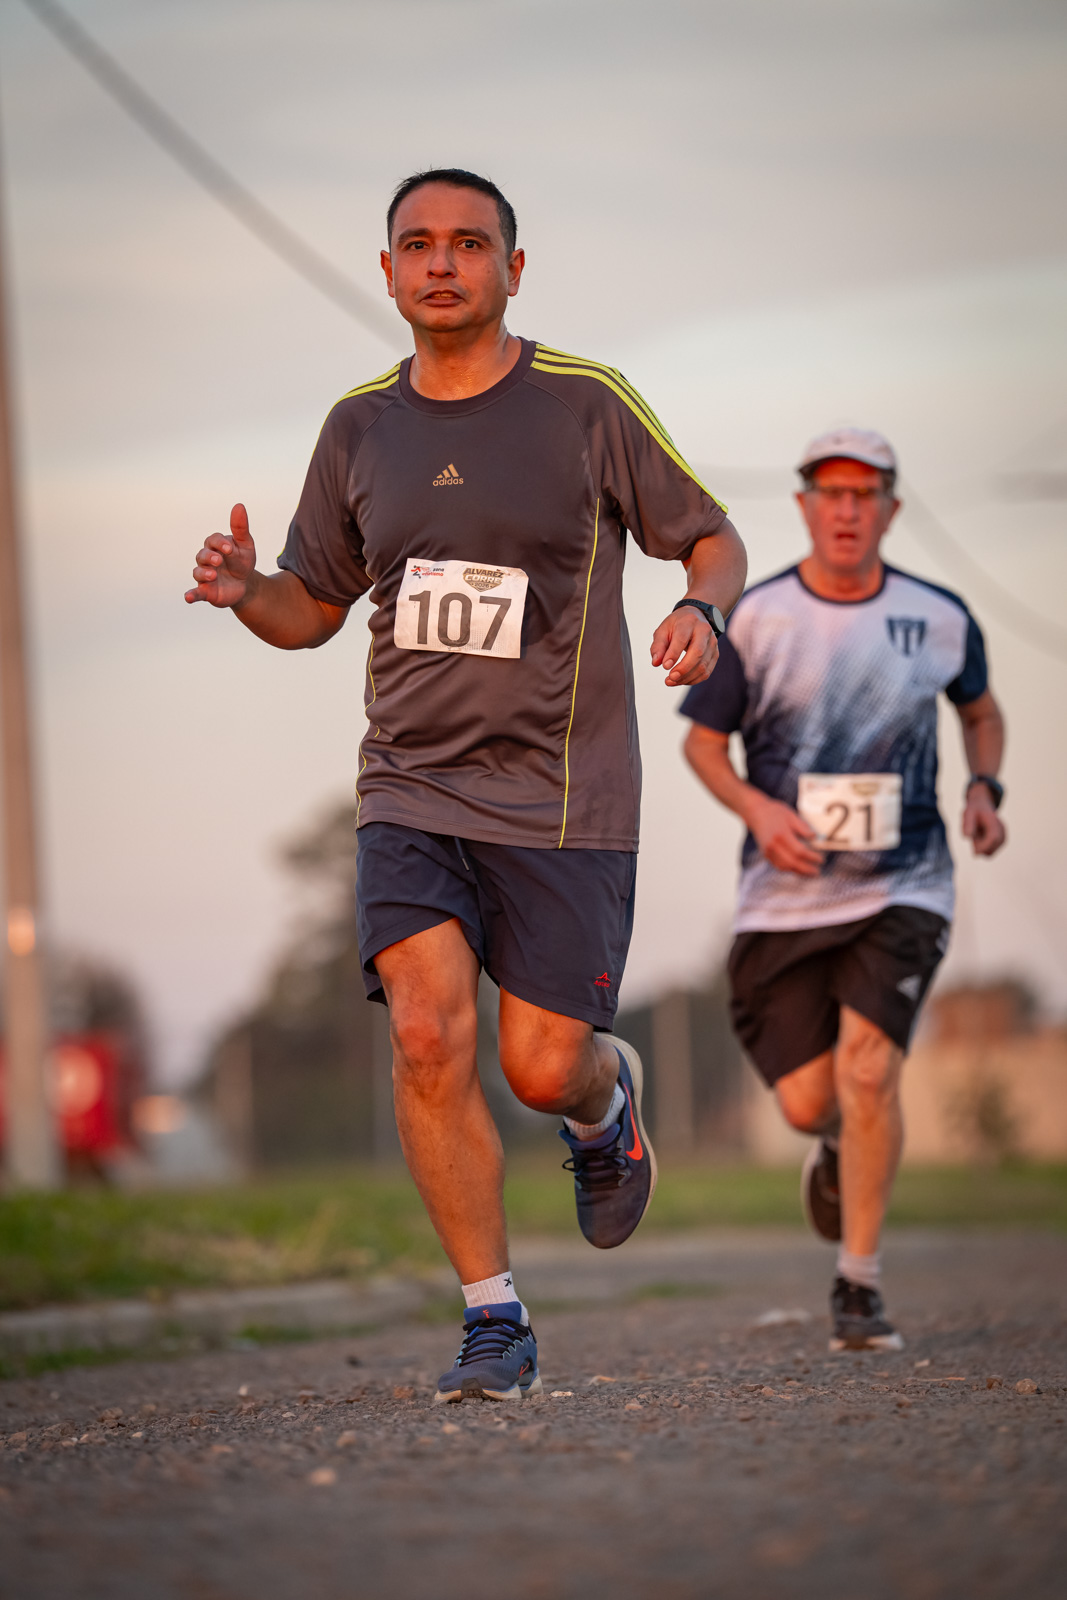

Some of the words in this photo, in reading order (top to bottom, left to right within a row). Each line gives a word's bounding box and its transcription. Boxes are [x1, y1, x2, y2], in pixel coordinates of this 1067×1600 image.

[432, 477, 464, 487] adidas
[463, 568, 504, 579] ALVAREZ
[465, 574, 503, 584] CORRE
[408, 590, 512, 651] 107
[825, 802, 873, 844] 21
